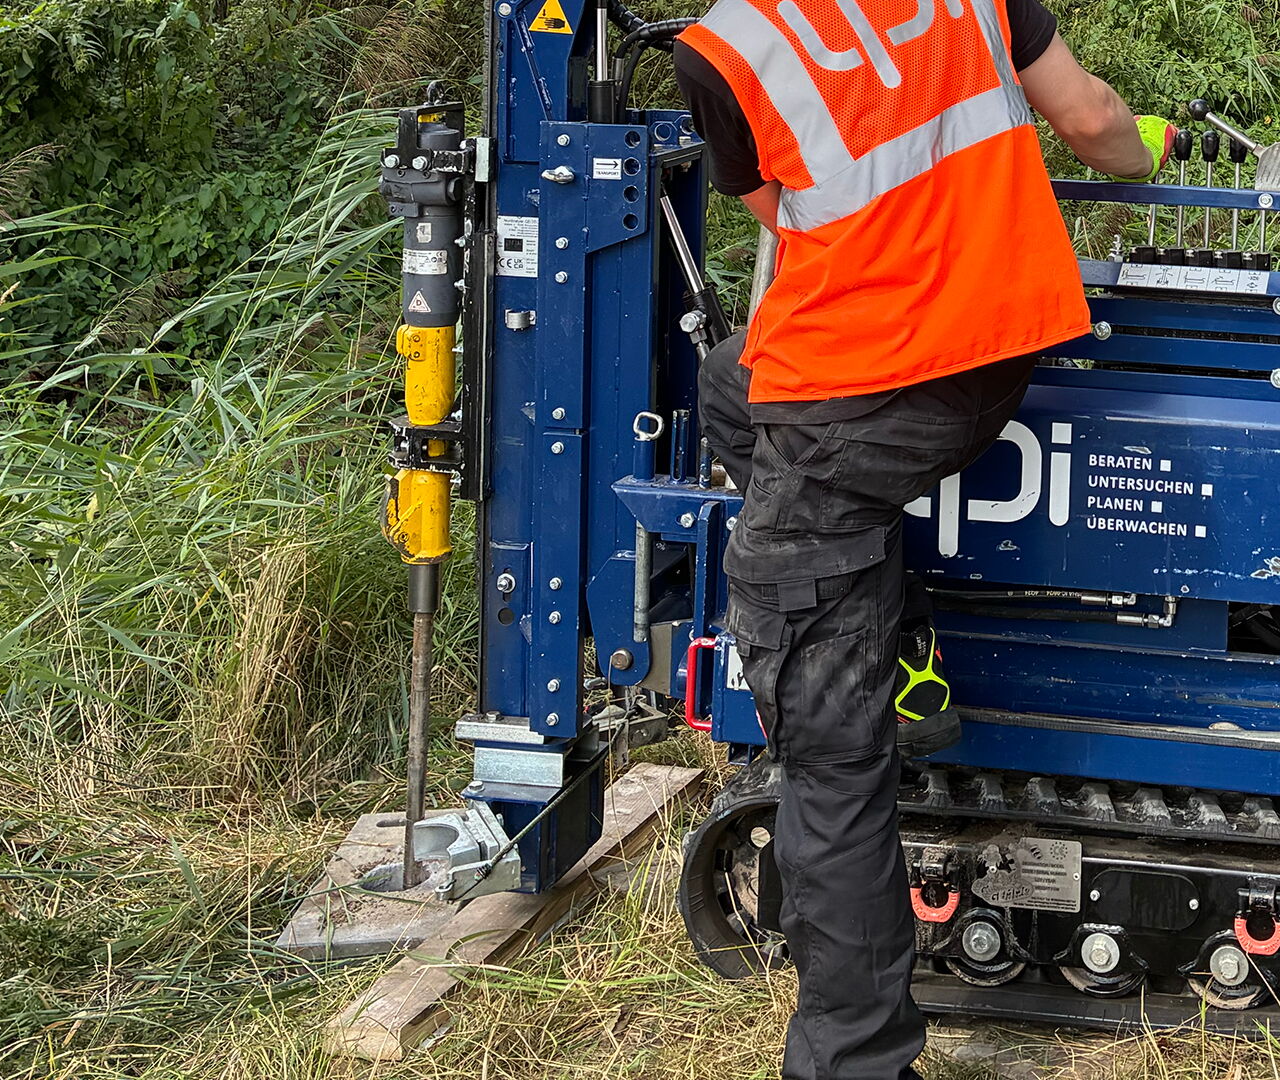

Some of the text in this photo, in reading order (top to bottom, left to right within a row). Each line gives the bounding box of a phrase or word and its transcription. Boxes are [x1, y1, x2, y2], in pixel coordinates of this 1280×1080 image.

[1089, 454, 1152, 471] BERATEN
[1088, 475, 1194, 495] UNTERSUCHEN
[1087, 496, 1143, 512] PLANEN
